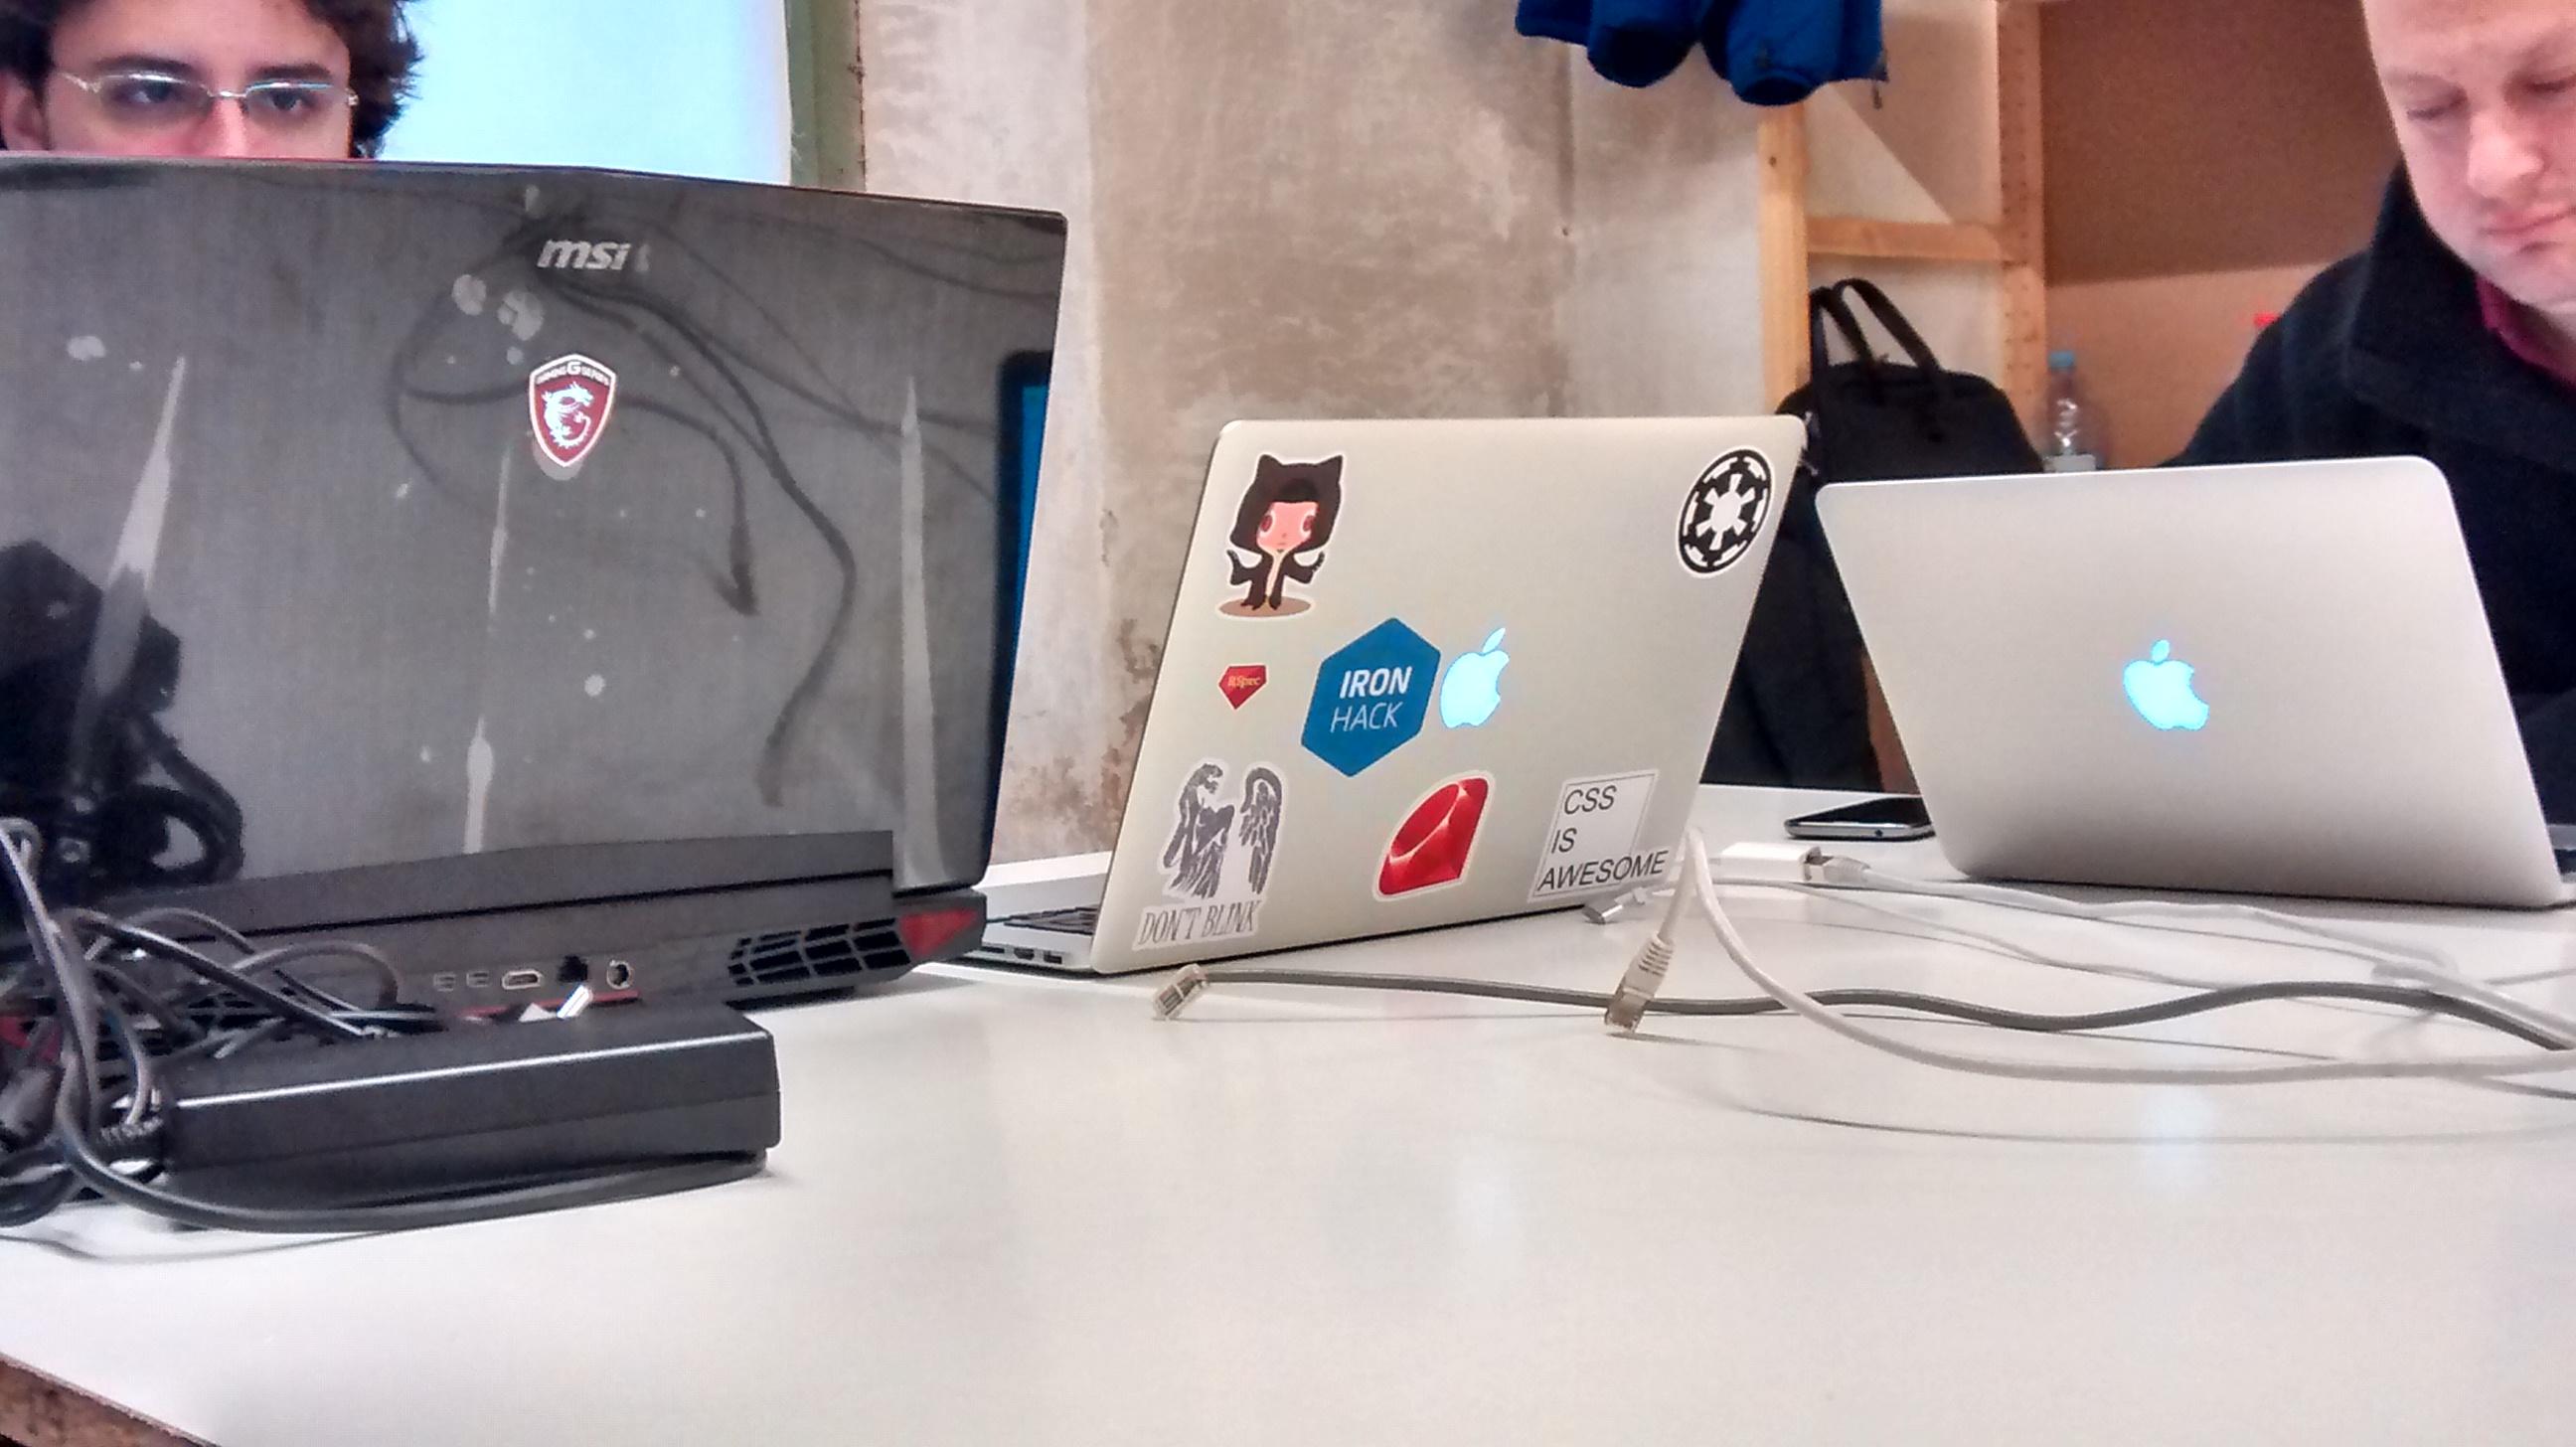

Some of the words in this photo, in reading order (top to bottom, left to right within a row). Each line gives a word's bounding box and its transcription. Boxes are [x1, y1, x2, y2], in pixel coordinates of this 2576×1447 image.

[537, 240, 631, 270] msi
[1339, 666, 1412, 699] IRON
[1330, 702, 1403, 732] HACK
[1564, 785, 1617, 815] CSS
[1550, 827, 1577, 854] IS
[1536, 850, 1669, 891] AWESOME
[1202, 899, 1261, 937] BLINK
